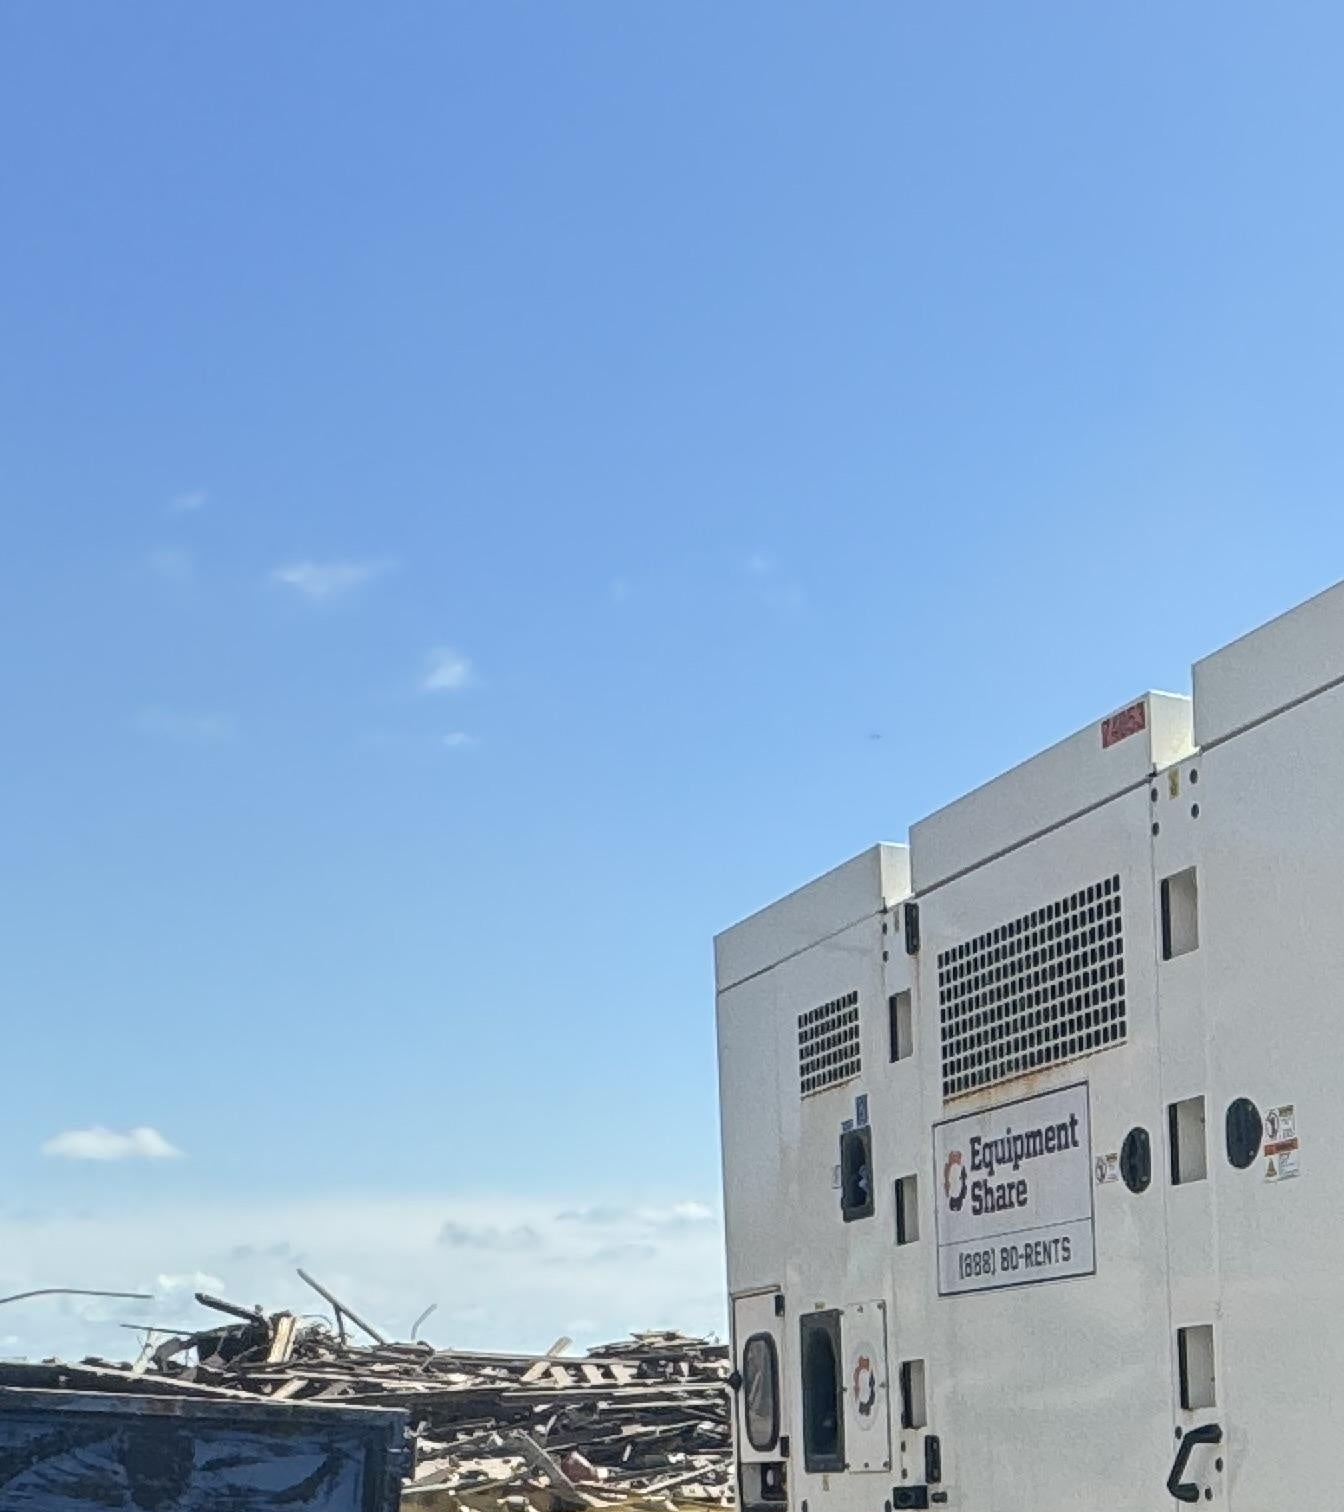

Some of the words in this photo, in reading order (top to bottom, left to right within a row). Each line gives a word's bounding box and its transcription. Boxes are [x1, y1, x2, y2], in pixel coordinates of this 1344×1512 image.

[970, 1112, 1079, 1177] Equipment
[971, 1178, 1028, 1216] Share
[958, 1247, 996, 1280] (888)
[1000, 1236, 1072, 1272] 80-RENTS
